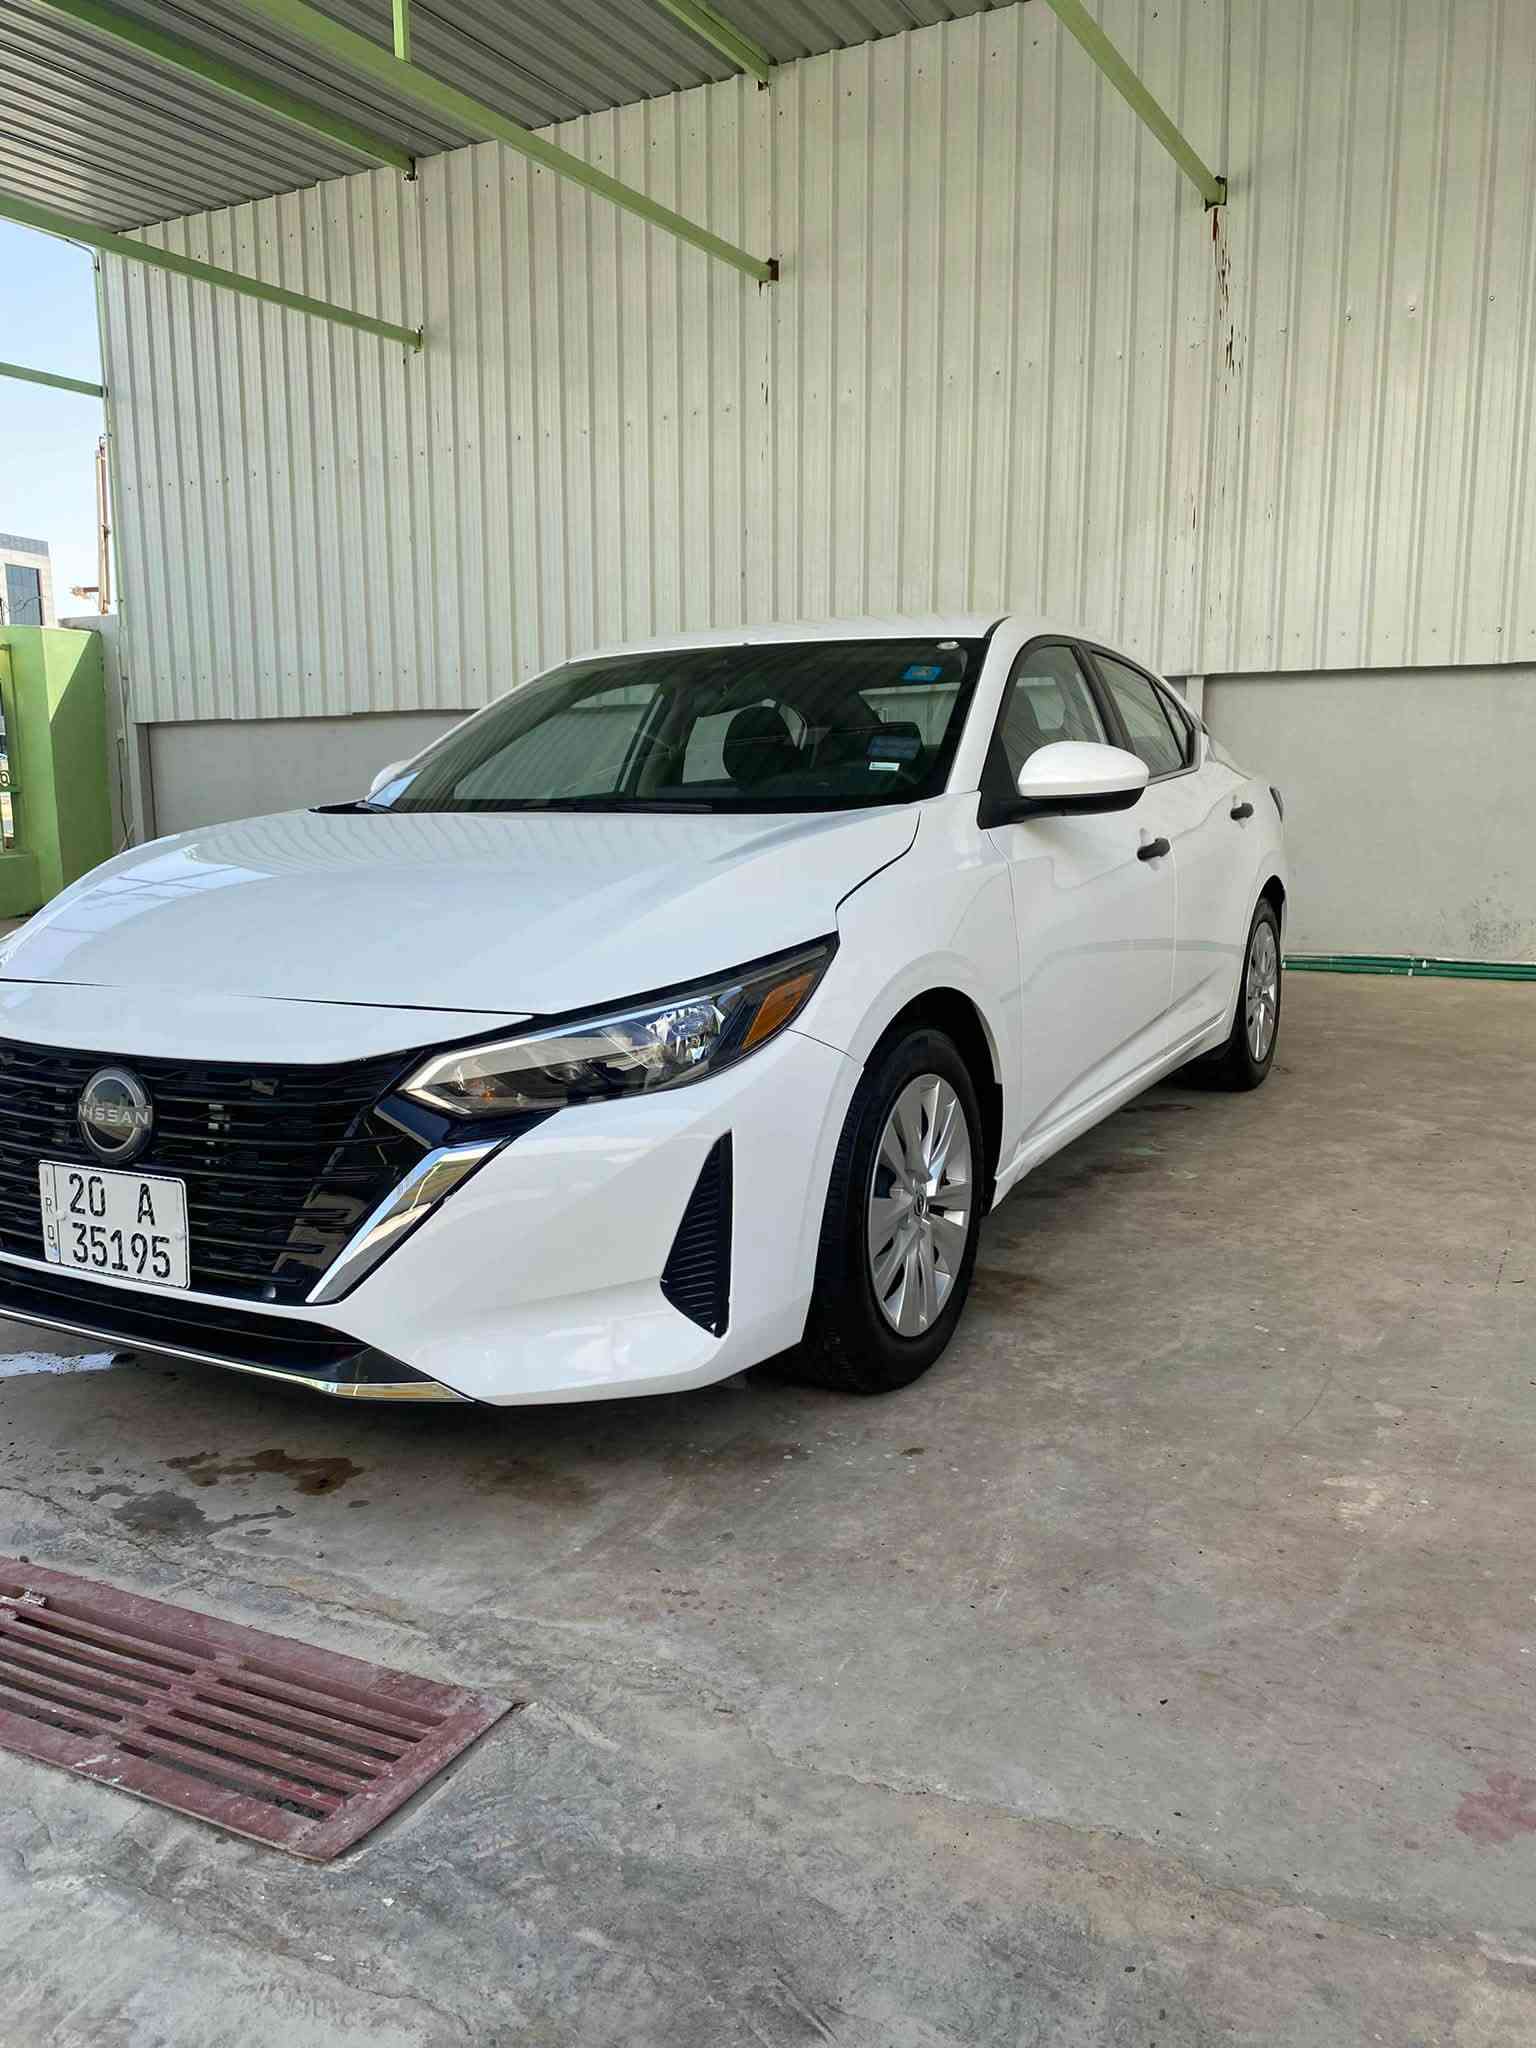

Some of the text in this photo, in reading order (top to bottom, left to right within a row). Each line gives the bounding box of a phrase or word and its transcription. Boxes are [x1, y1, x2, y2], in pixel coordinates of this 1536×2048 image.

[80, 1103, 149, 1125] NISSAN
[69, 1173, 155, 1226] 20 A
[72, 1222, 171, 1279] 35195
